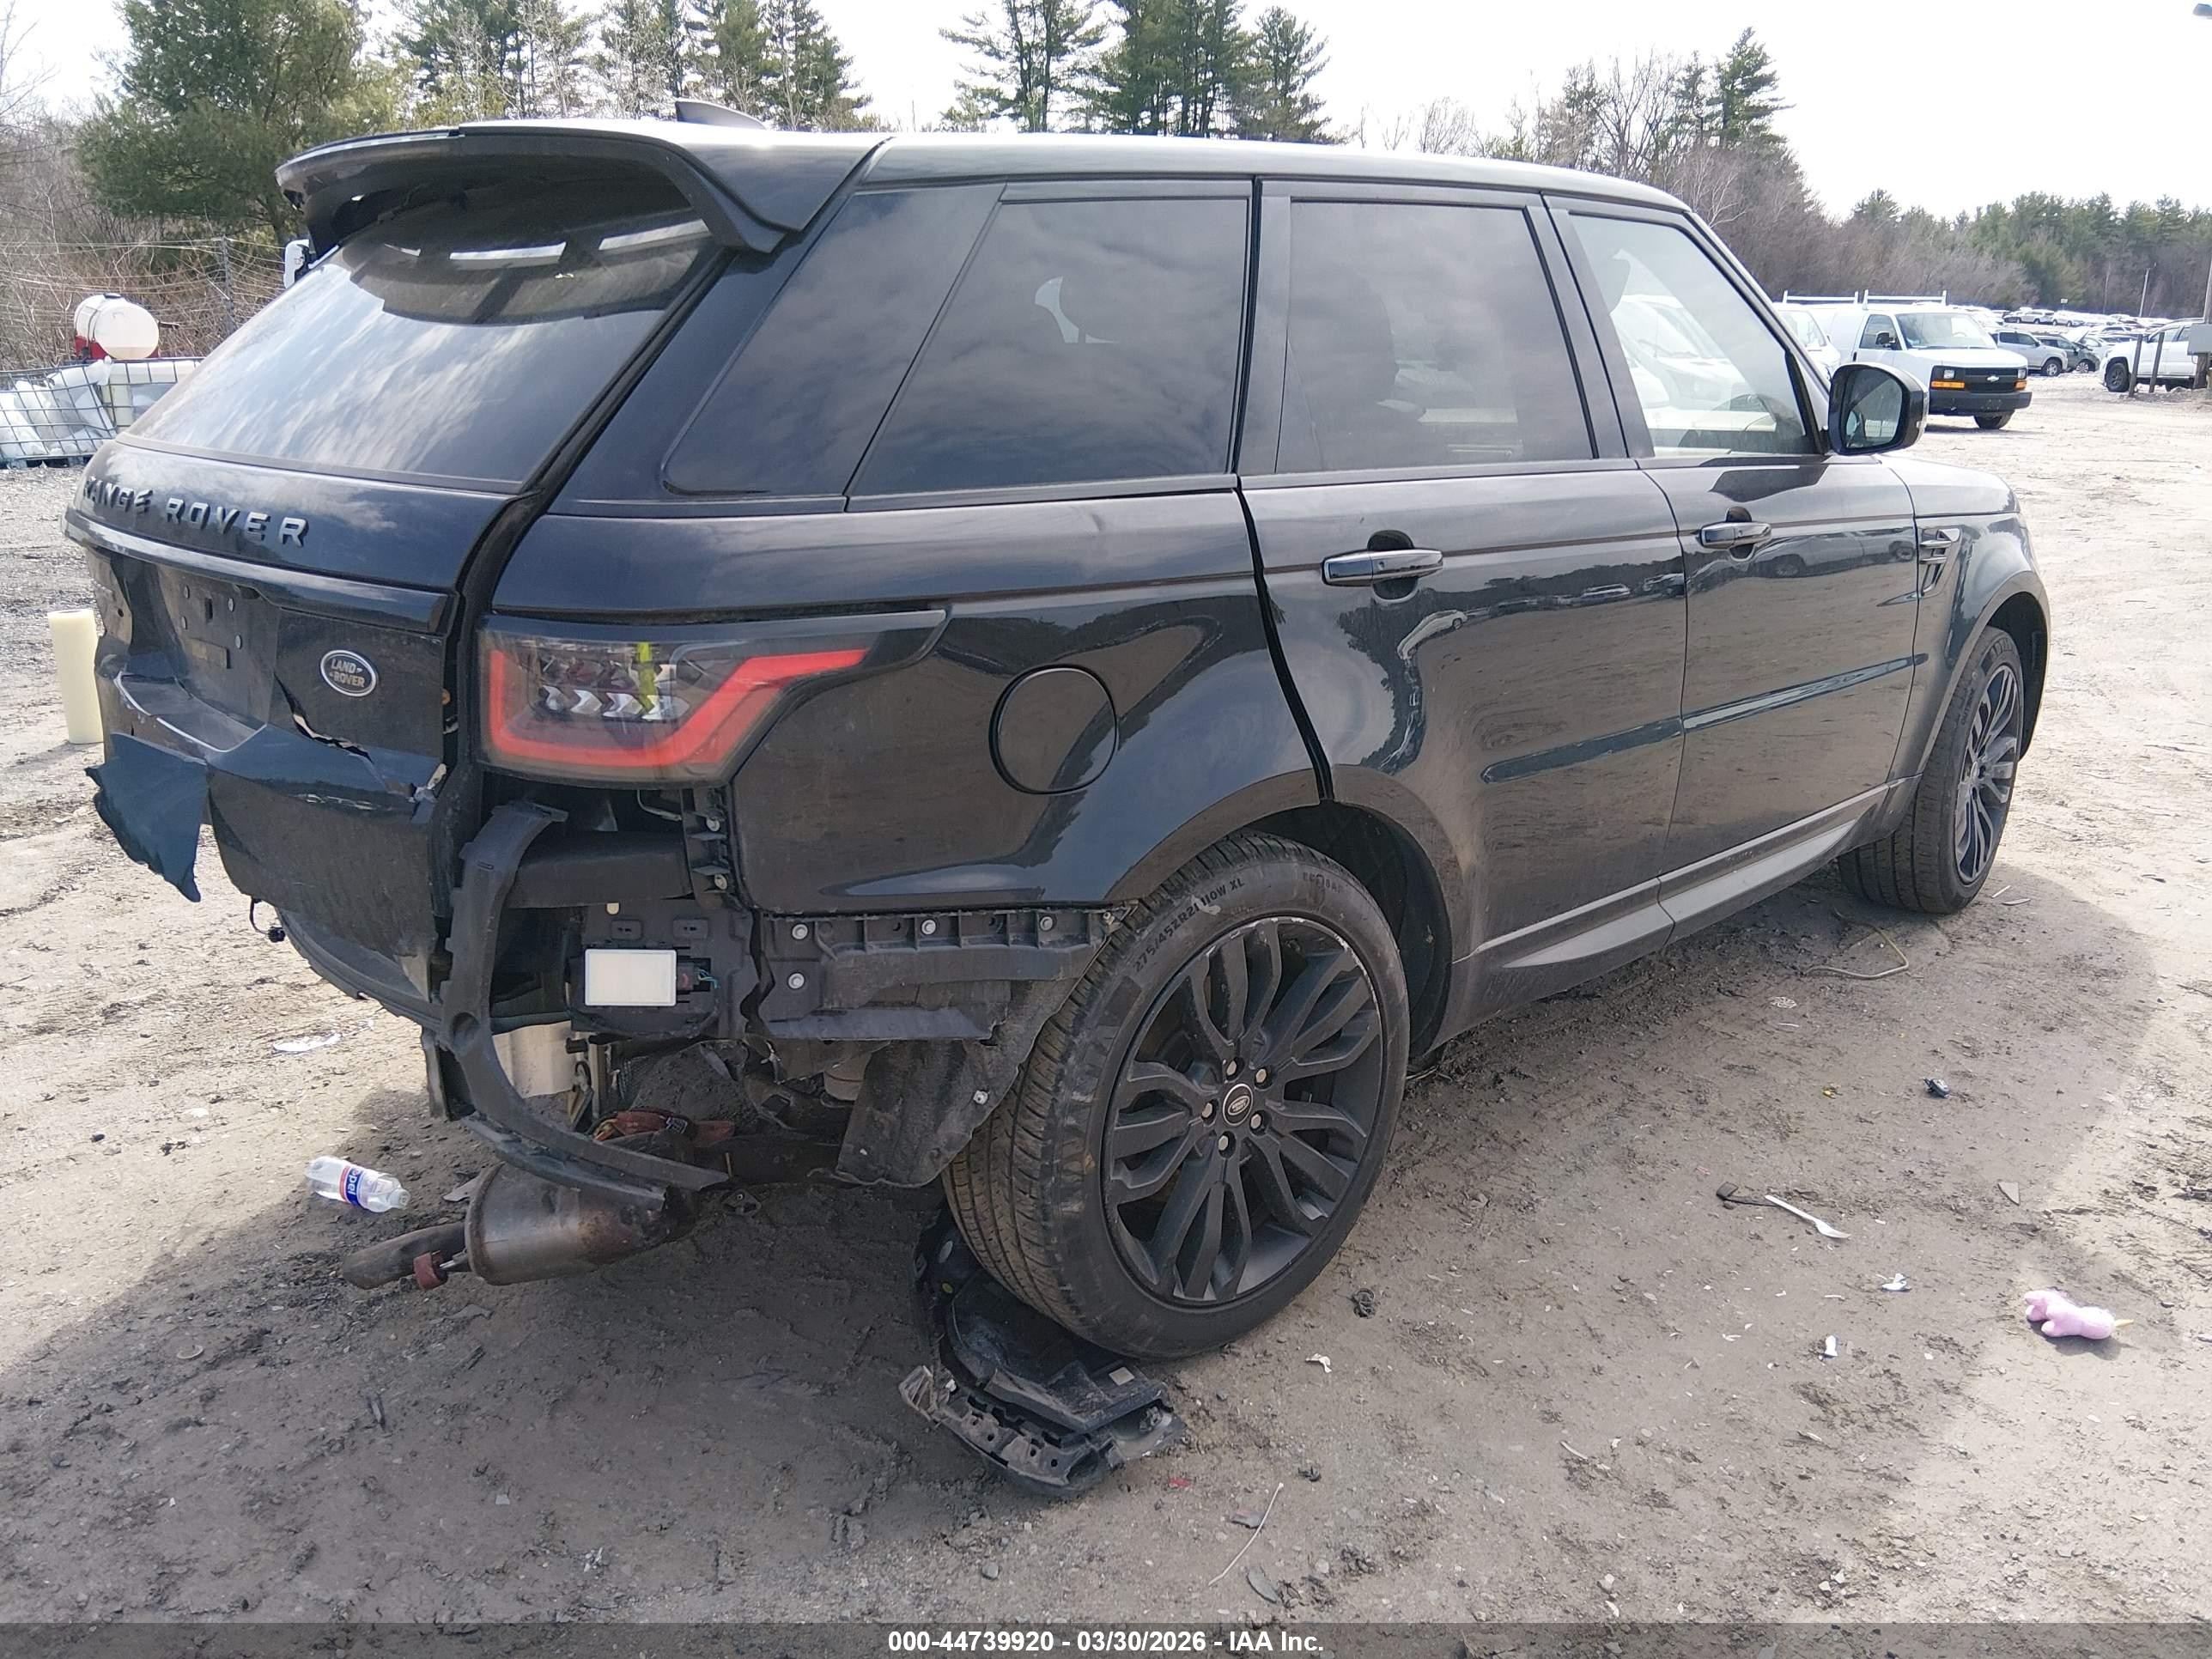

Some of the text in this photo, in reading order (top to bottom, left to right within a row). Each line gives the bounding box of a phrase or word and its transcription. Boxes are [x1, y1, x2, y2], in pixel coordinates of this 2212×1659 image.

[166, 497, 309, 547] ROVER
[331, 658, 357, 674] LAND
[332, 670, 366, 688] ROVER
[1230, 878, 1245, 890] XL
